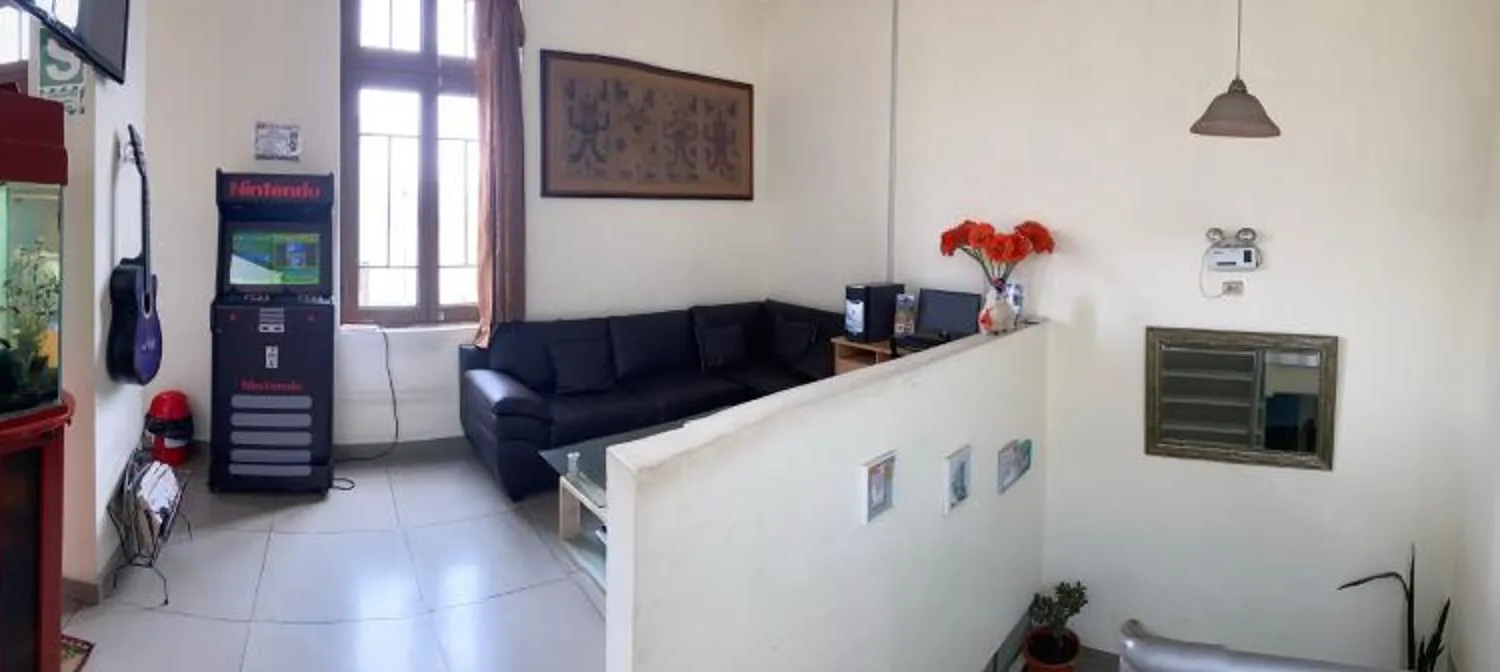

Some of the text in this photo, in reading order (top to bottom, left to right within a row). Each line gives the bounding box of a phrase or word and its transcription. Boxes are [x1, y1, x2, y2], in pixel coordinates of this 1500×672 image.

[45, 36, 82, 81] S
[228, 180, 321, 199] Nintendo
[240, 378, 304, 391] Nintendo
